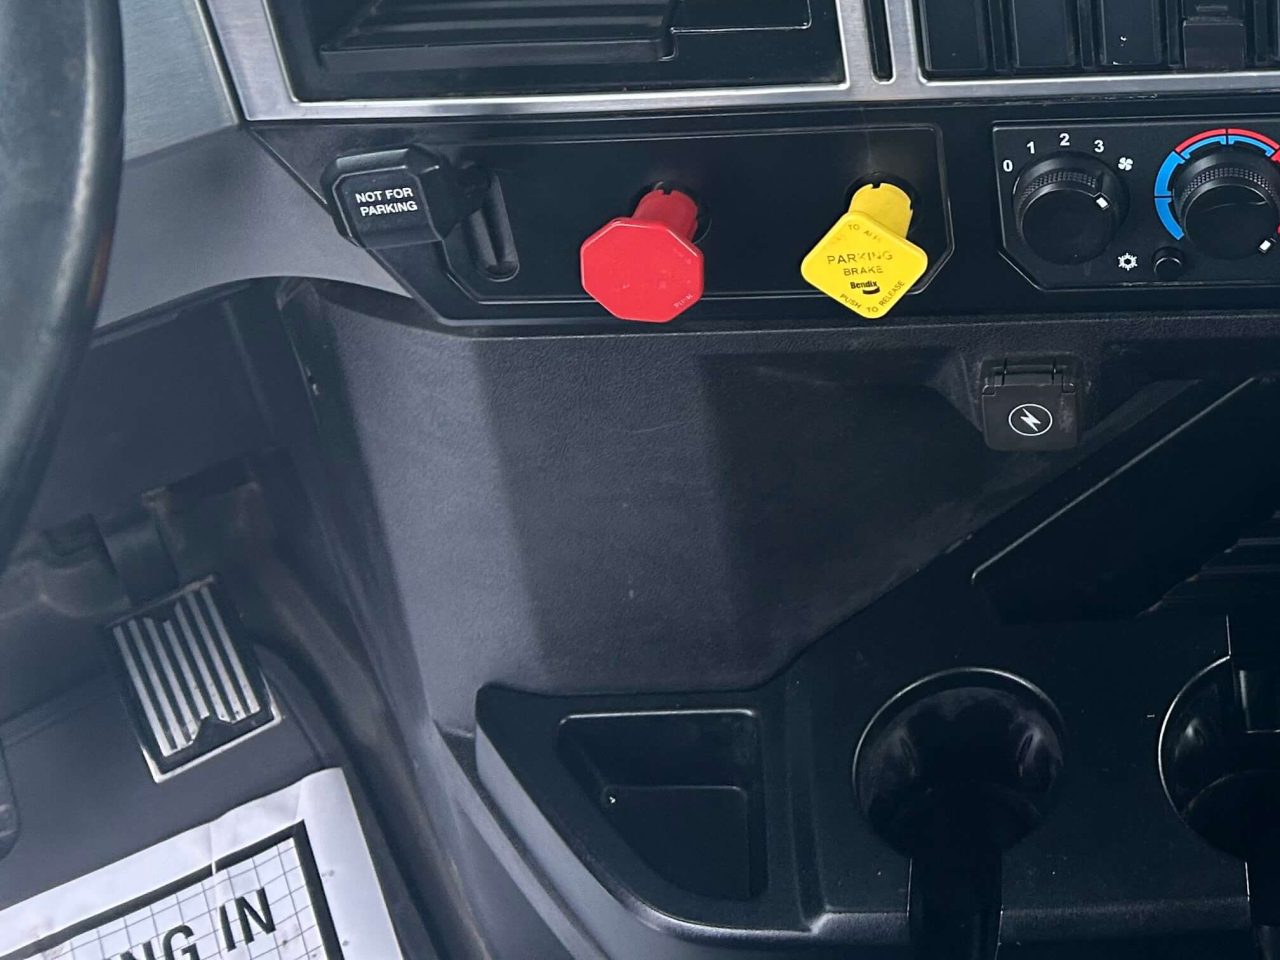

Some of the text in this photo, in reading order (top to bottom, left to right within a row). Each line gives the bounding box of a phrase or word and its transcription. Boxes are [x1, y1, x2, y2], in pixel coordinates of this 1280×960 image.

[1059, 132, 1070, 146] 2
[1094, 139, 1105, 153] 3
[1026, 141, 1035, 154] 1
[1003, 159, 1013, 172] 0
[354, 187, 413, 204] NOT FOR
[360, 200, 418, 217] PARKING
[843, 265, 884, 277] BRAKE
[850, 280, 878, 290] Bendix
[840, 293, 861, 309] PUSH
[879, 280, 905, 307] RELEASE
[219, 887, 277, 952] IN
